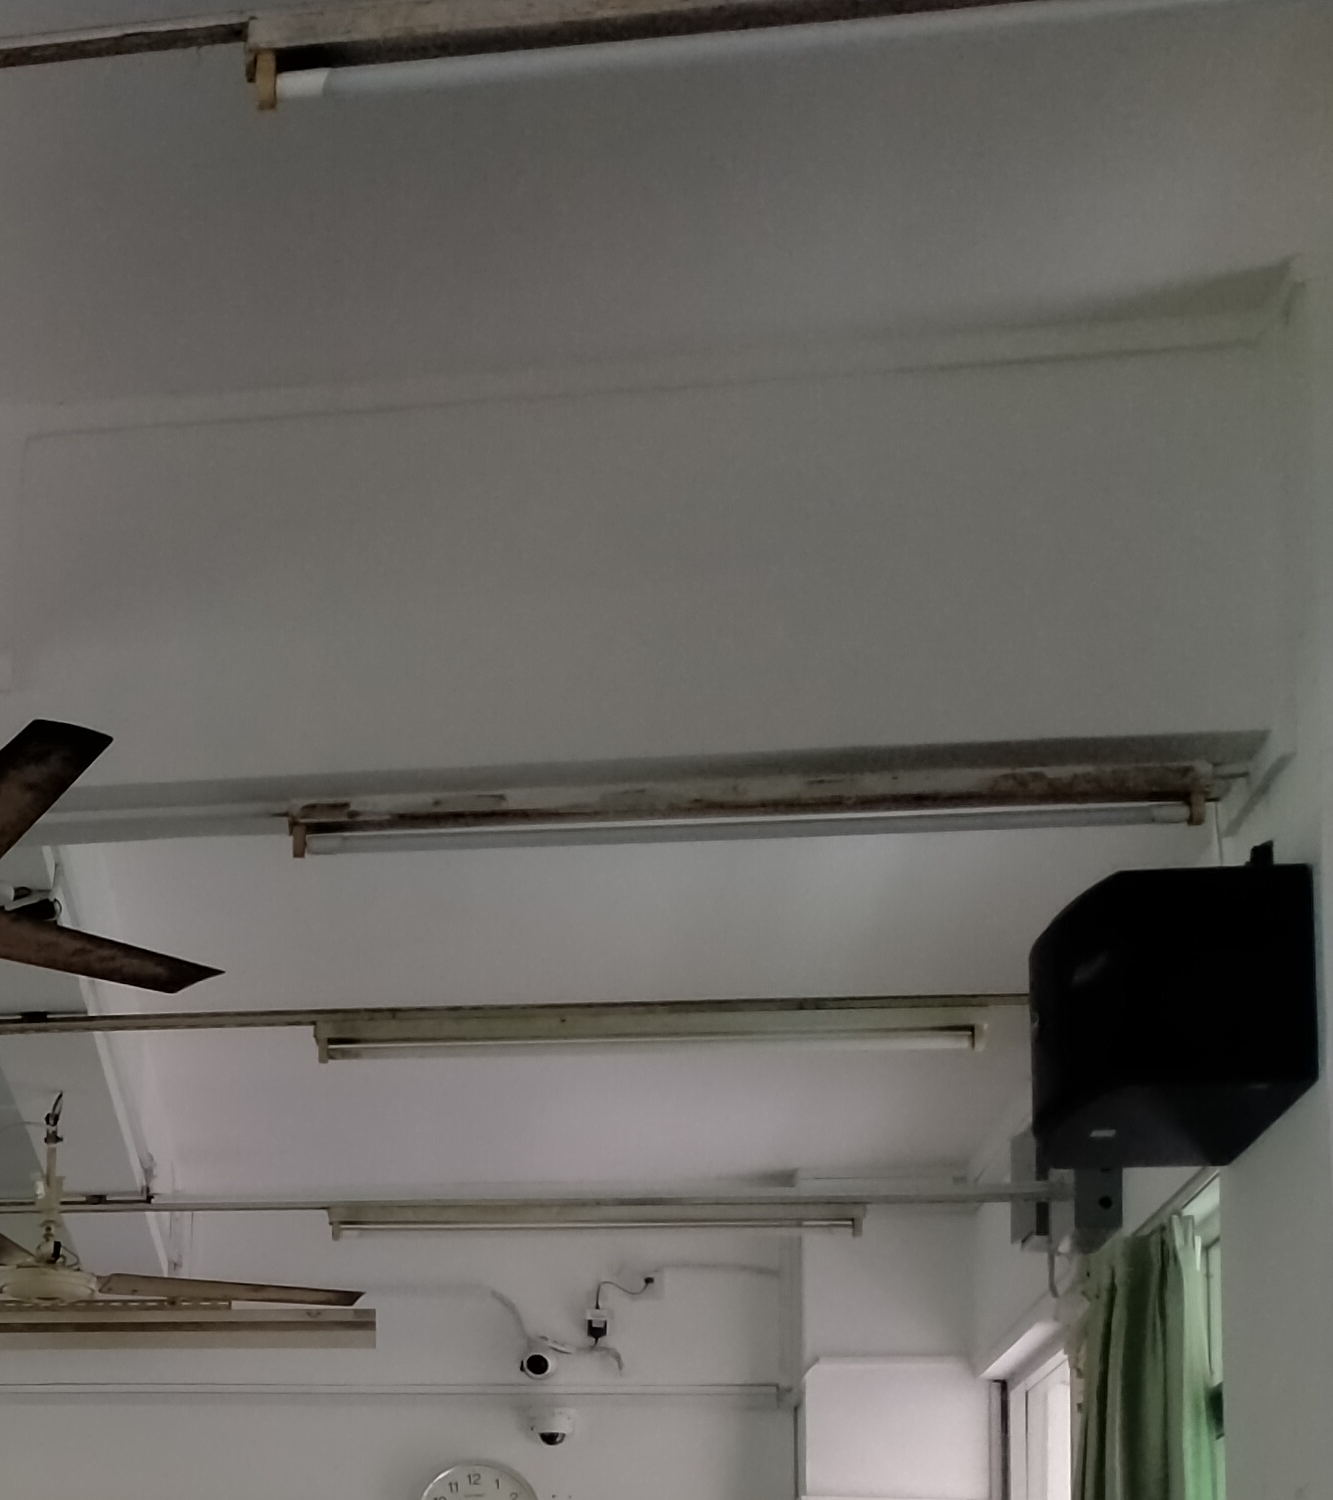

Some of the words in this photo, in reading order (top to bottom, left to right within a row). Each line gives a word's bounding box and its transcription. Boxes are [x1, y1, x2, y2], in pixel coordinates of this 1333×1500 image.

[467, 1473, 481, 1486] 12
[495, 1479, 500, 1490] 1
[448, 1482, 459, 1493] 11
